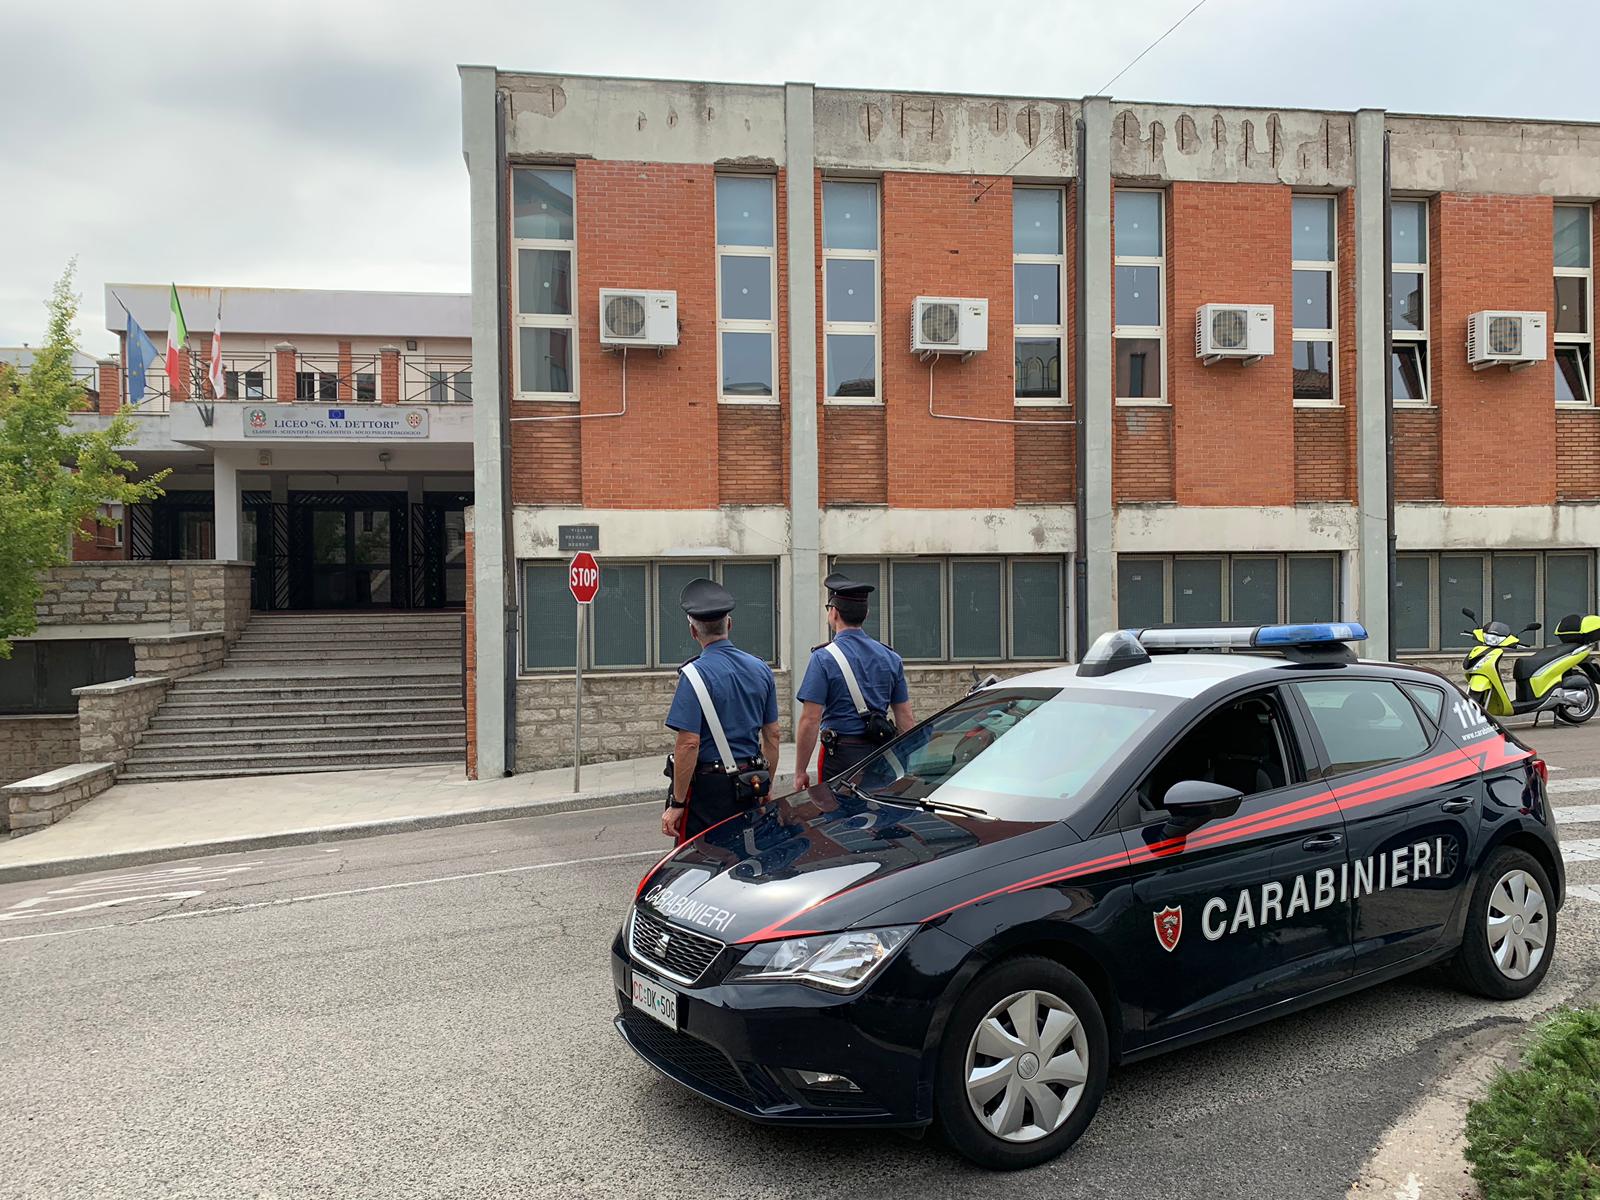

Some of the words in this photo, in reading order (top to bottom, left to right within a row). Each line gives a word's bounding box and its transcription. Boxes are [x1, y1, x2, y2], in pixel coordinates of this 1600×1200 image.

[274, 420, 308, 428] LICEO
[329, 420, 341, 428] M.
[571, 567, 597, 587] STOP
[1452, 698, 1488, 729] 112
[1201, 837, 1443, 941] CARABINIERI
[644, 884, 736, 933] CARABINIERI
